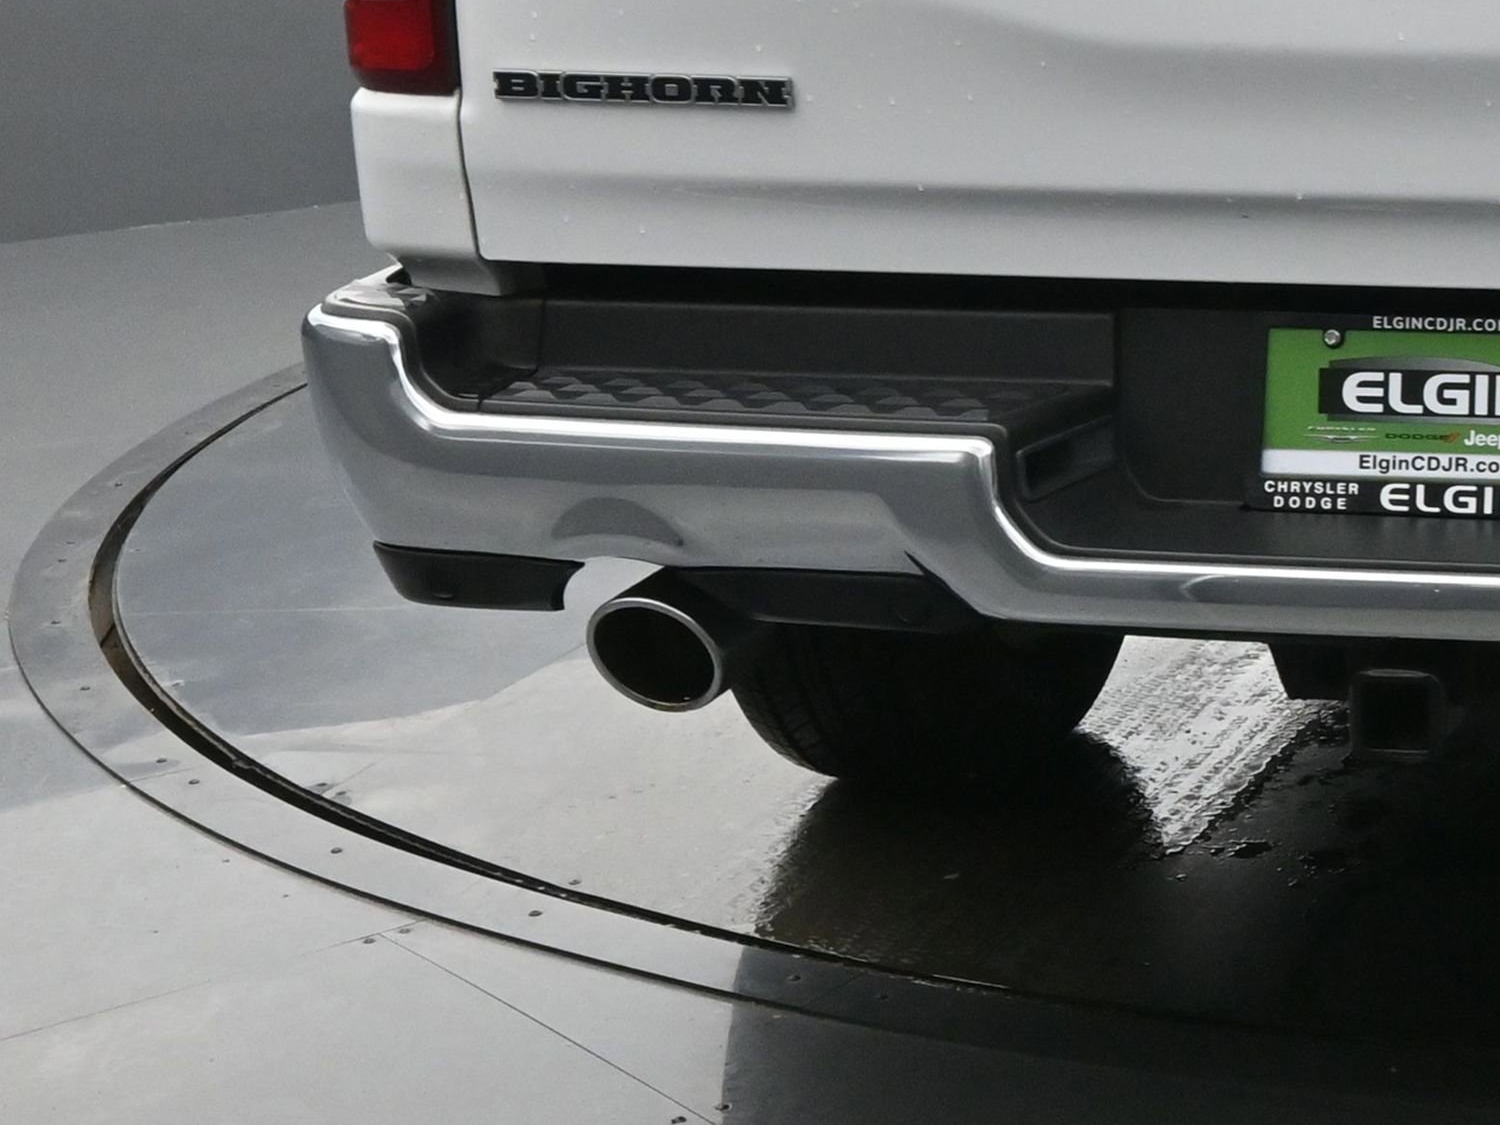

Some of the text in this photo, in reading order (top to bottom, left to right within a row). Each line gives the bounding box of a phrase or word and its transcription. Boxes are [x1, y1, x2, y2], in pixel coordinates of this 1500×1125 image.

[493, 69, 794, 108] BIGHORN
[1264, 480, 1359, 495] CHRYSLER
[1273, 495, 1347, 509] DODGE
